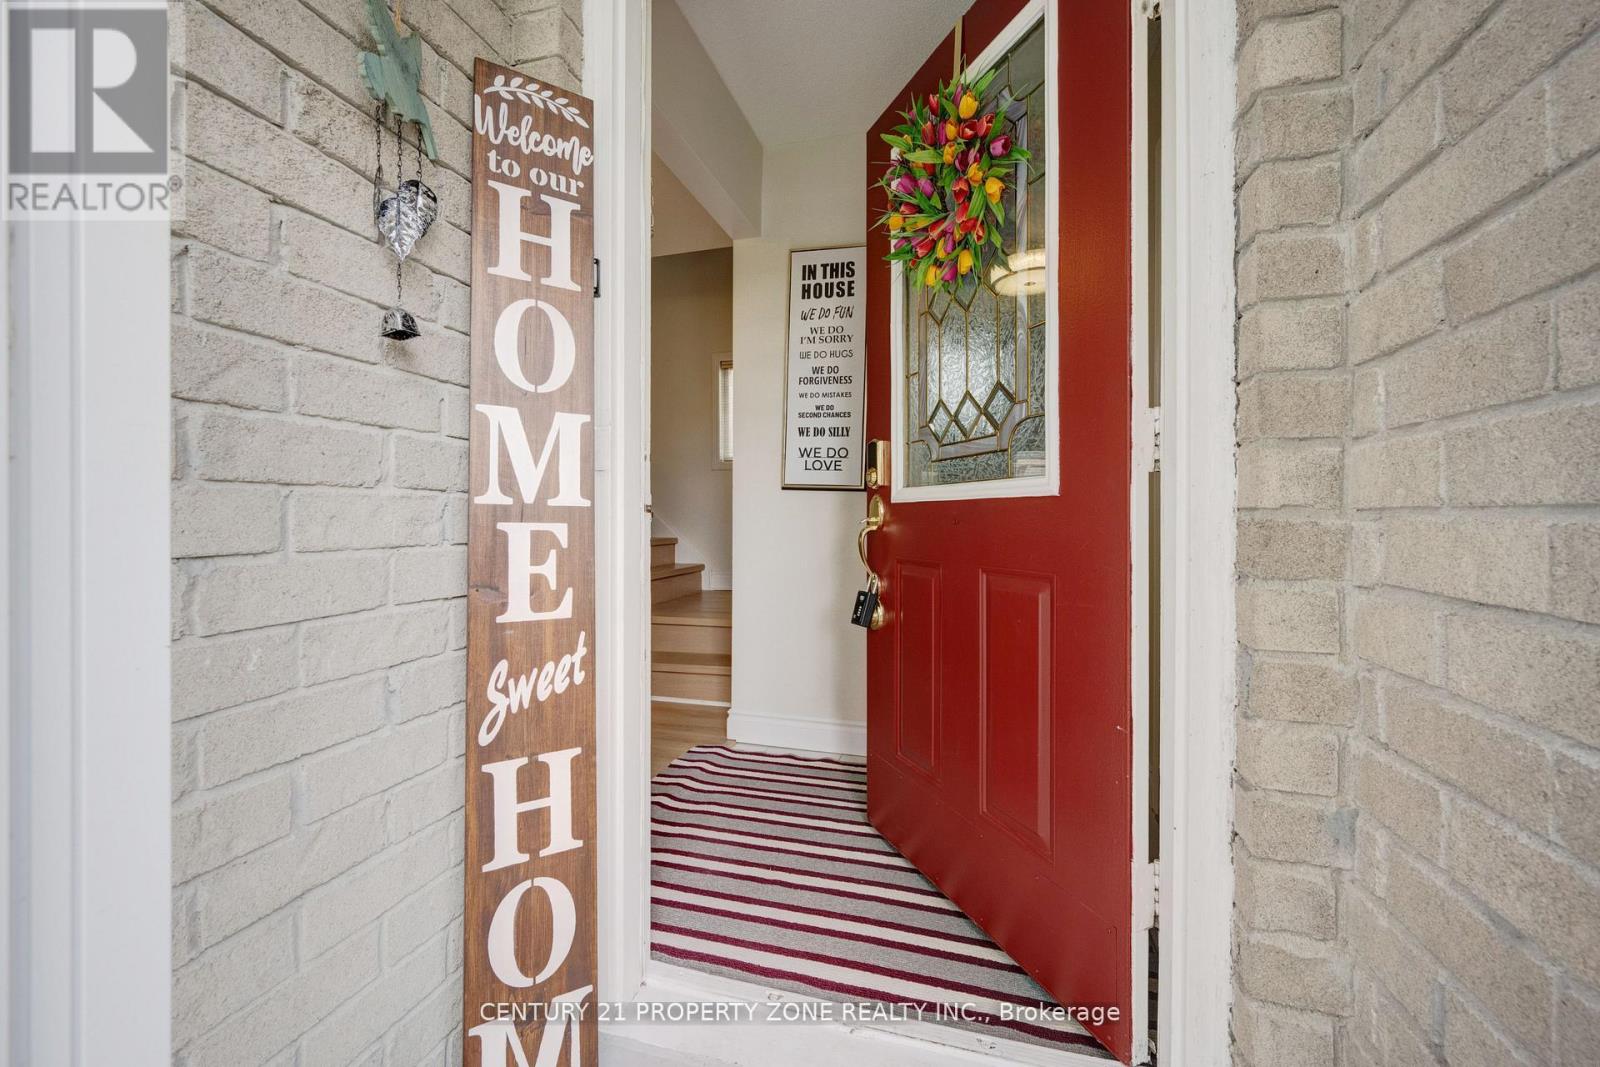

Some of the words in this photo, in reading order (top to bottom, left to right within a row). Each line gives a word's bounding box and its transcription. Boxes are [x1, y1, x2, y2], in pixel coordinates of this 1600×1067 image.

[474, 93, 594, 175] Welcome
[487, 149, 521, 178] to
[529, 167, 585, 197] our
[802, 264, 817, 281] IN
[820, 261, 855, 280] THIS
[801, 280, 855, 300] HOUSE
[800, 307, 817, 321] WE
[818, 307, 831, 320] DO
[833, 304, 855, 320] FUN
[810, 326, 825, 335] WE
[828, 325, 844, 335] DO
[800, 335, 816, 345] I'M
[818, 334, 854, 344] SORRY
[800, 351, 812, 360] WE
[814, 350, 828, 359] DO
[829, 349, 854, 359] HUGS
[811, 366, 825, 375] WE
[827, 365, 840, 374] DO
[798, 375, 853, 386] FORGIVENESS
[821, 391, 852, 399] MISTAKES
[798, 427, 811, 437] WE
[813, 427, 826, 437] DO
[828, 426, 851, 438] SILLY
[798, 447, 822, 458] WE
[827, 446, 849, 459] DO
[804, 459, 843, 471] LOVE
[478, 630, 587, 746] Sweet
